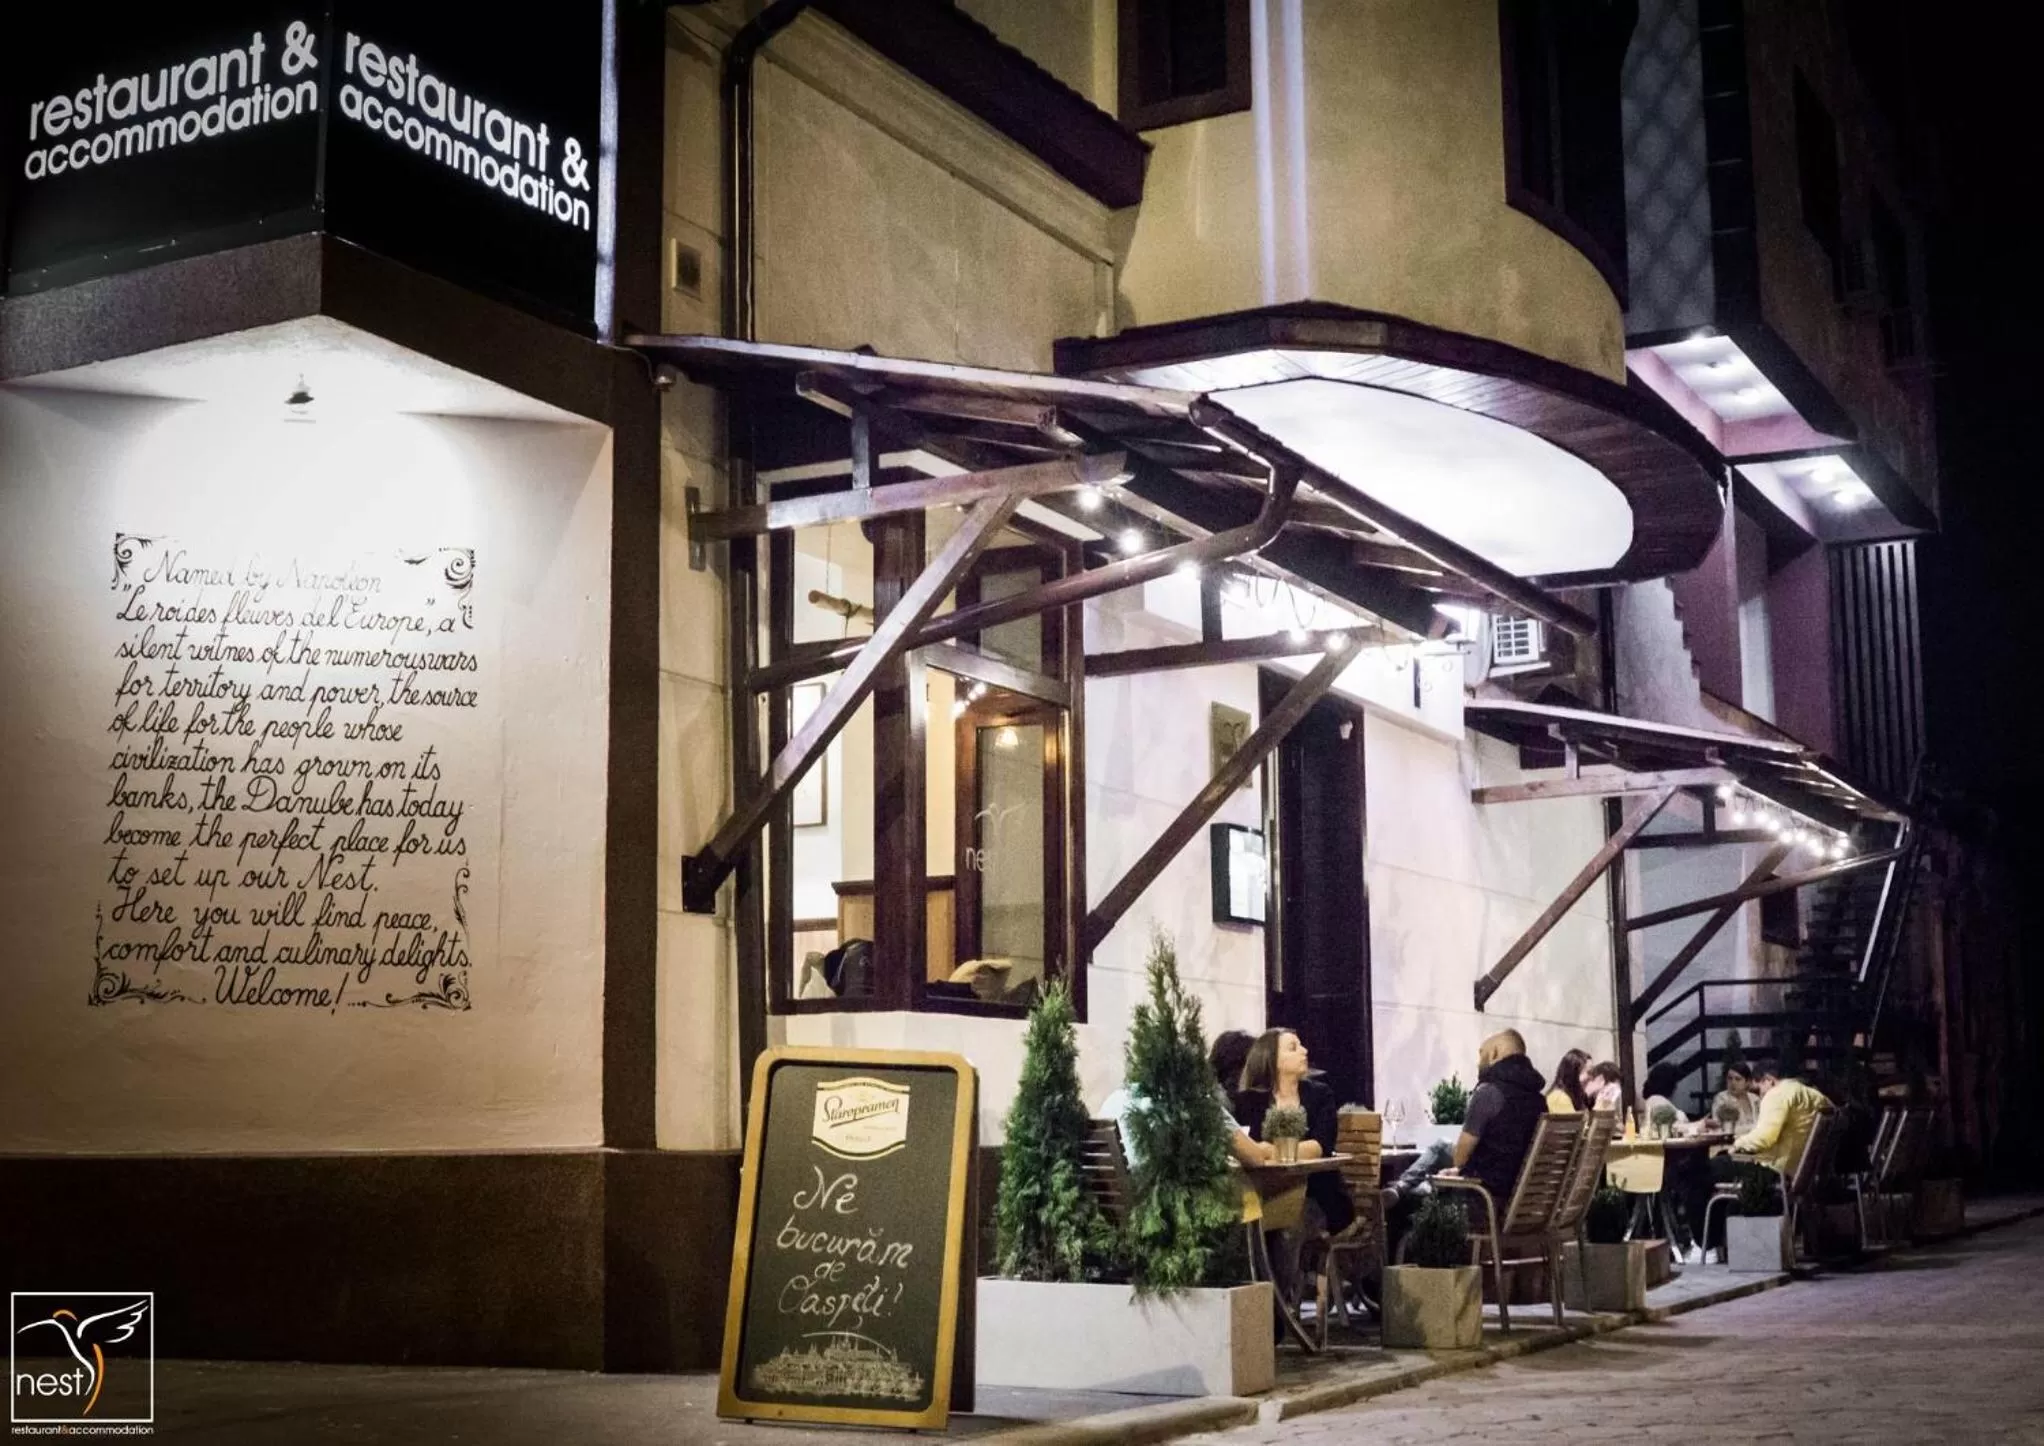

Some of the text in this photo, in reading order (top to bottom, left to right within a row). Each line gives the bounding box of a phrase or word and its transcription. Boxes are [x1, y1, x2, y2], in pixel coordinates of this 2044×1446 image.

[29, 20, 318, 140] restaurant &
[24, 80, 318, 180] accommodation
[346, 32, 591, 191] restaurant &
[339, 82, 590, 230] accommodation
[144, 549, 237, 587] Named
[115, 624, 479, 674] silent witnes of the numerous wars
[436, 616, 456, 634] a
[114, 660, 479, 717] for territory and power, the source
[108, 700, 404, 750] of life for the people whose
[109, 735, 441, 796] civilization has grown on its
[106, 772, 464, 837] banks, the Danube has today
[103, 810, 467, 867] become the perfect place for us
[107, 848, 378, 902] to set up our Nest.
[112, 885, 438, 946] Here you will find peace,
[102, 926, 473, 985] comfort and culinary delights.
[214, 964, 350, 1016] Welcome!
[822, 1095, 900, 1123] Staropramen
[793, 1164, 859, 1214] Ne
[776, 1214, 914, 1269] bucurăm
[814, 1259, 847, 1283] de
